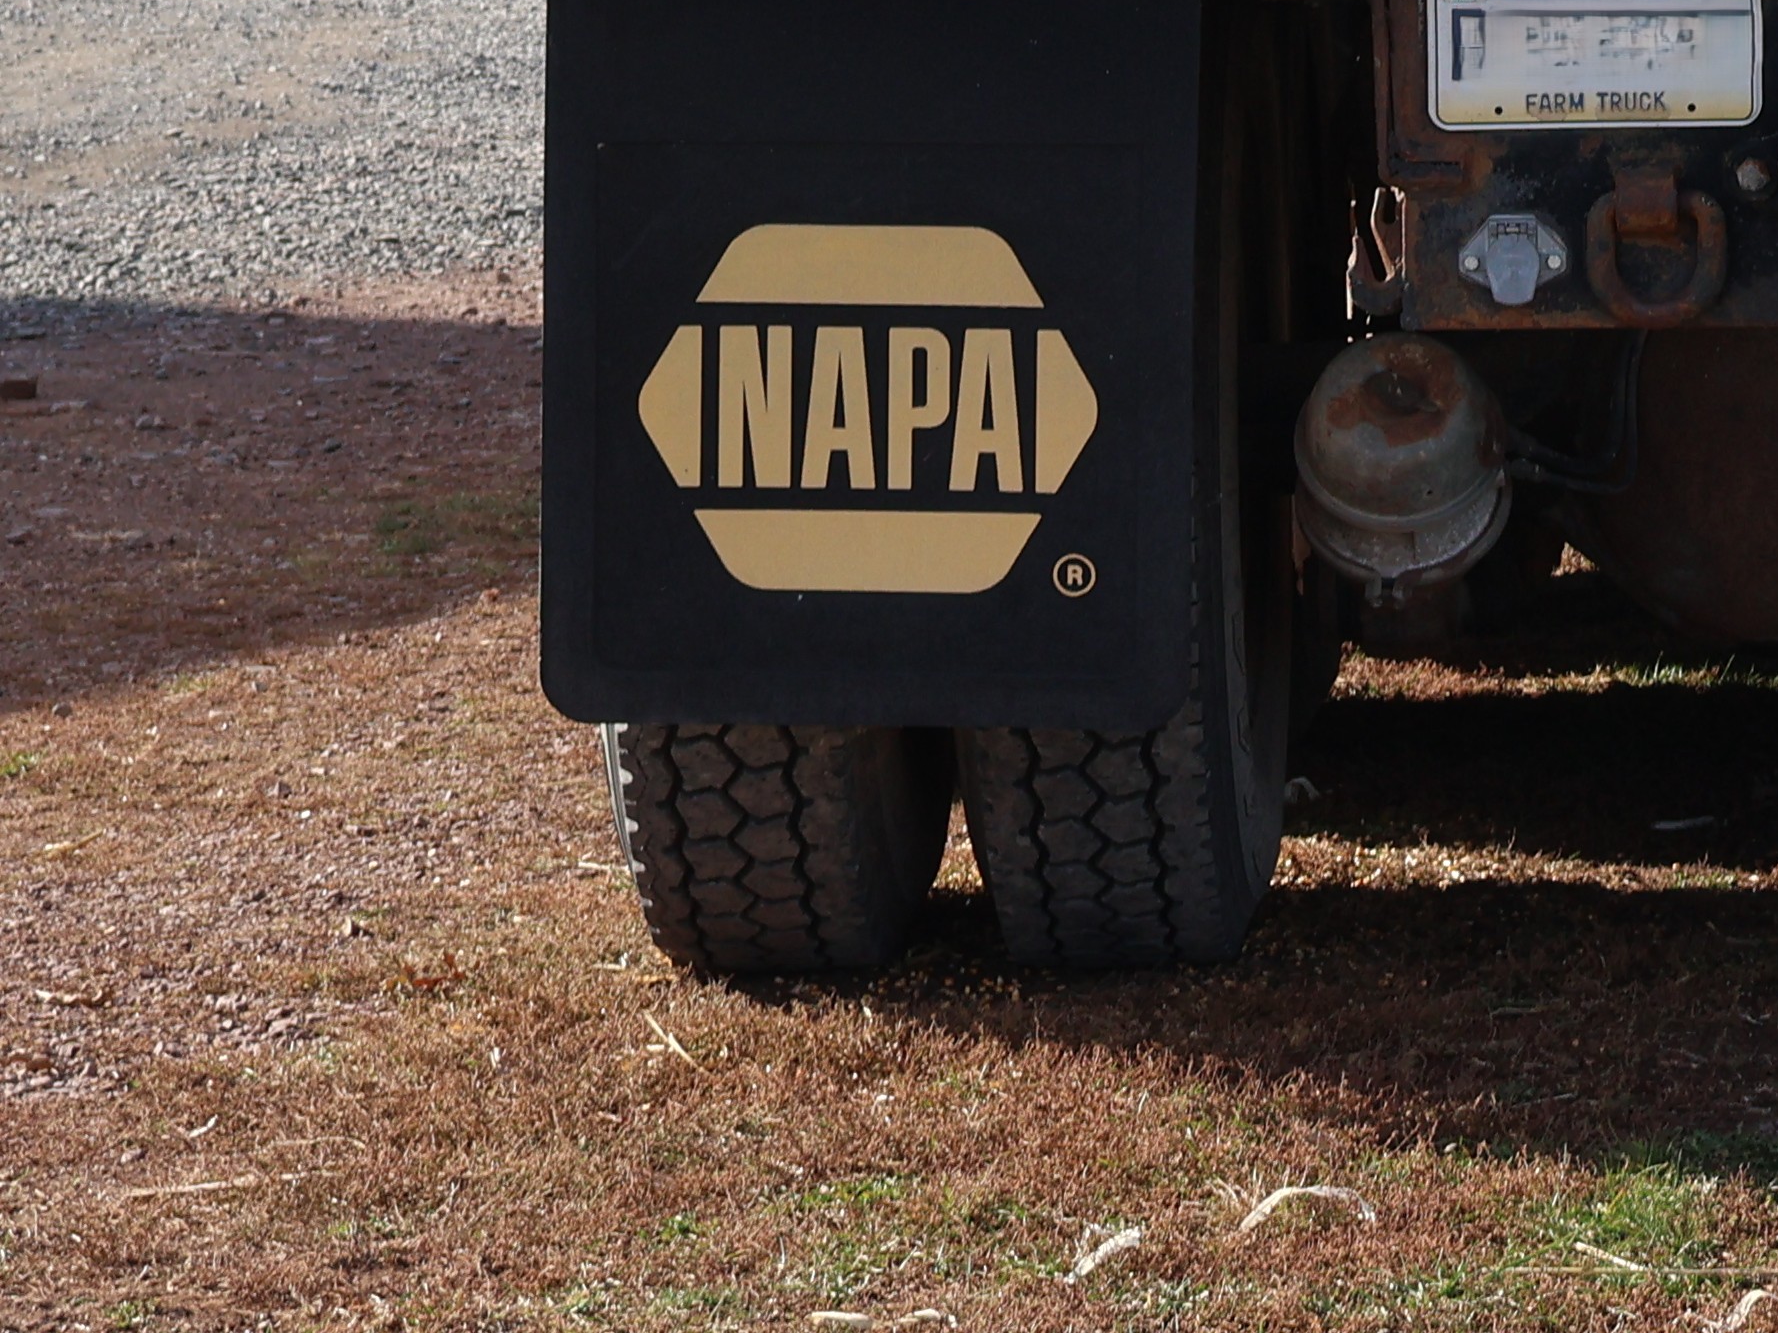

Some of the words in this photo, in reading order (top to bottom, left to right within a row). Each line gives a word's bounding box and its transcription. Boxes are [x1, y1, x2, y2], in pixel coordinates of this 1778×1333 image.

[1525, 92, 1585, 114] FARM
[1596, 91, 1667, 112] TRUCK
[718, 325, 1023, 493] NAPA
